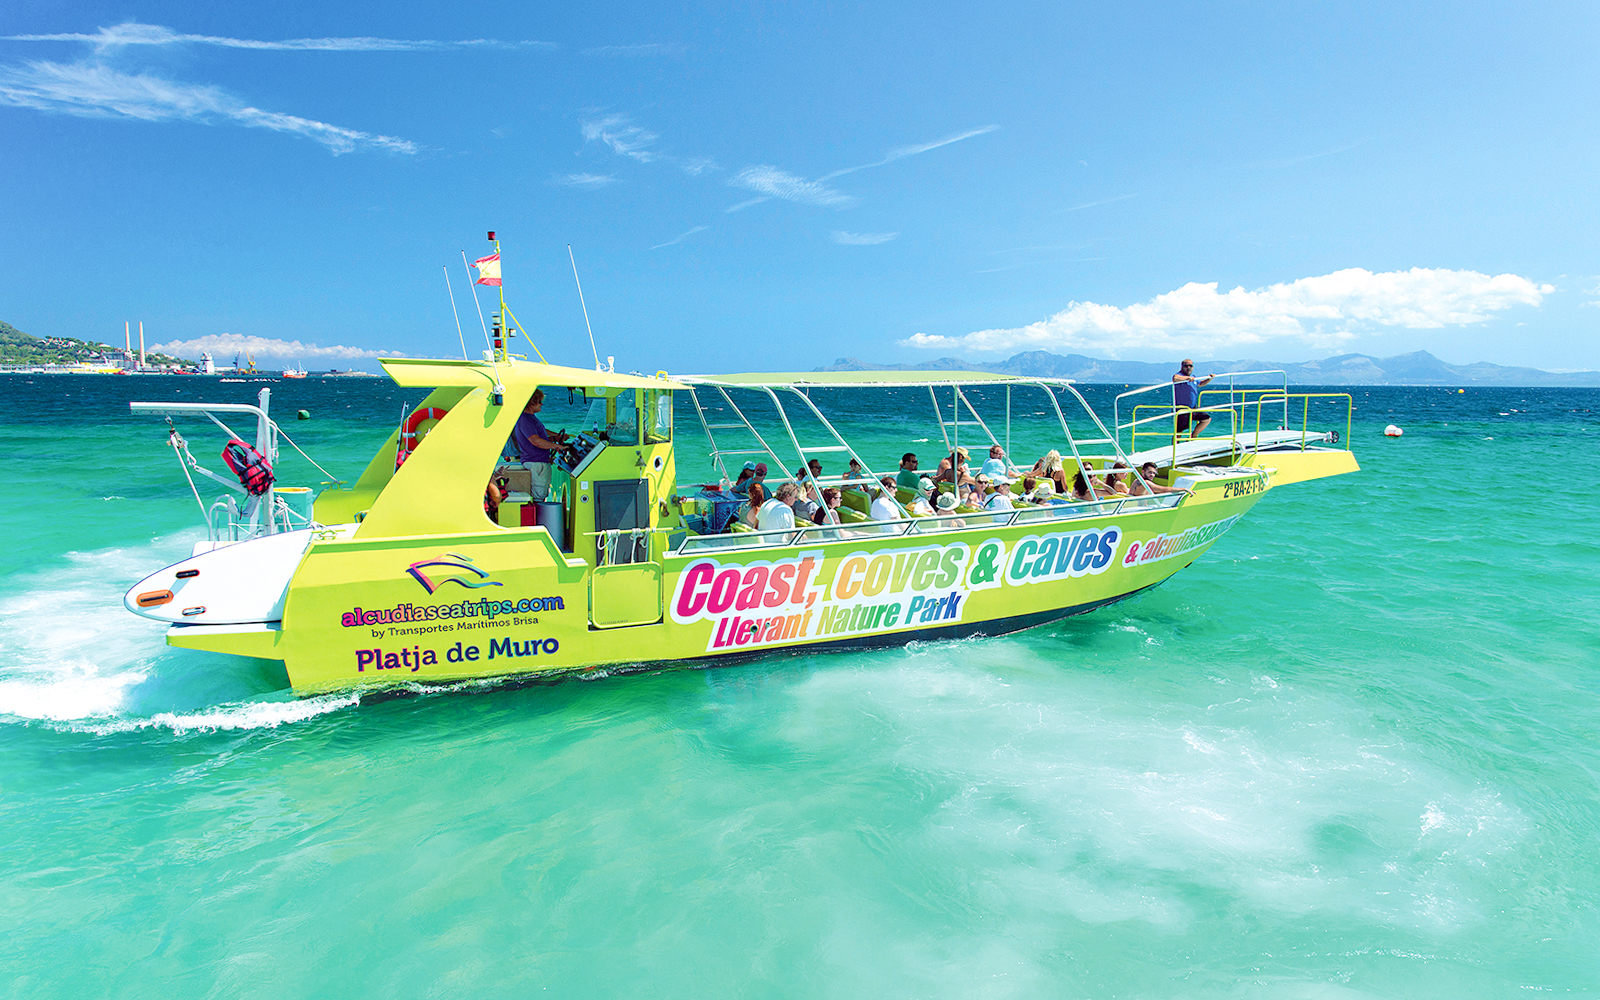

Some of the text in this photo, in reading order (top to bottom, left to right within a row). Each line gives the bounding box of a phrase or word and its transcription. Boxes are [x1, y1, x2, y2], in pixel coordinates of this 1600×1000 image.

[1125, 543, 1140, 563] &
[677, 530, 1118, 617] Coast, coves & caves
[341, 594, 565, 628] alcudiaseatrips.com
[371, 615, 539, 639] by Transportes Marítimos Brisa
[712, 591, 962, 648] Llevant Nature Park
[355, 636, 560, 673] Platja de Muro
